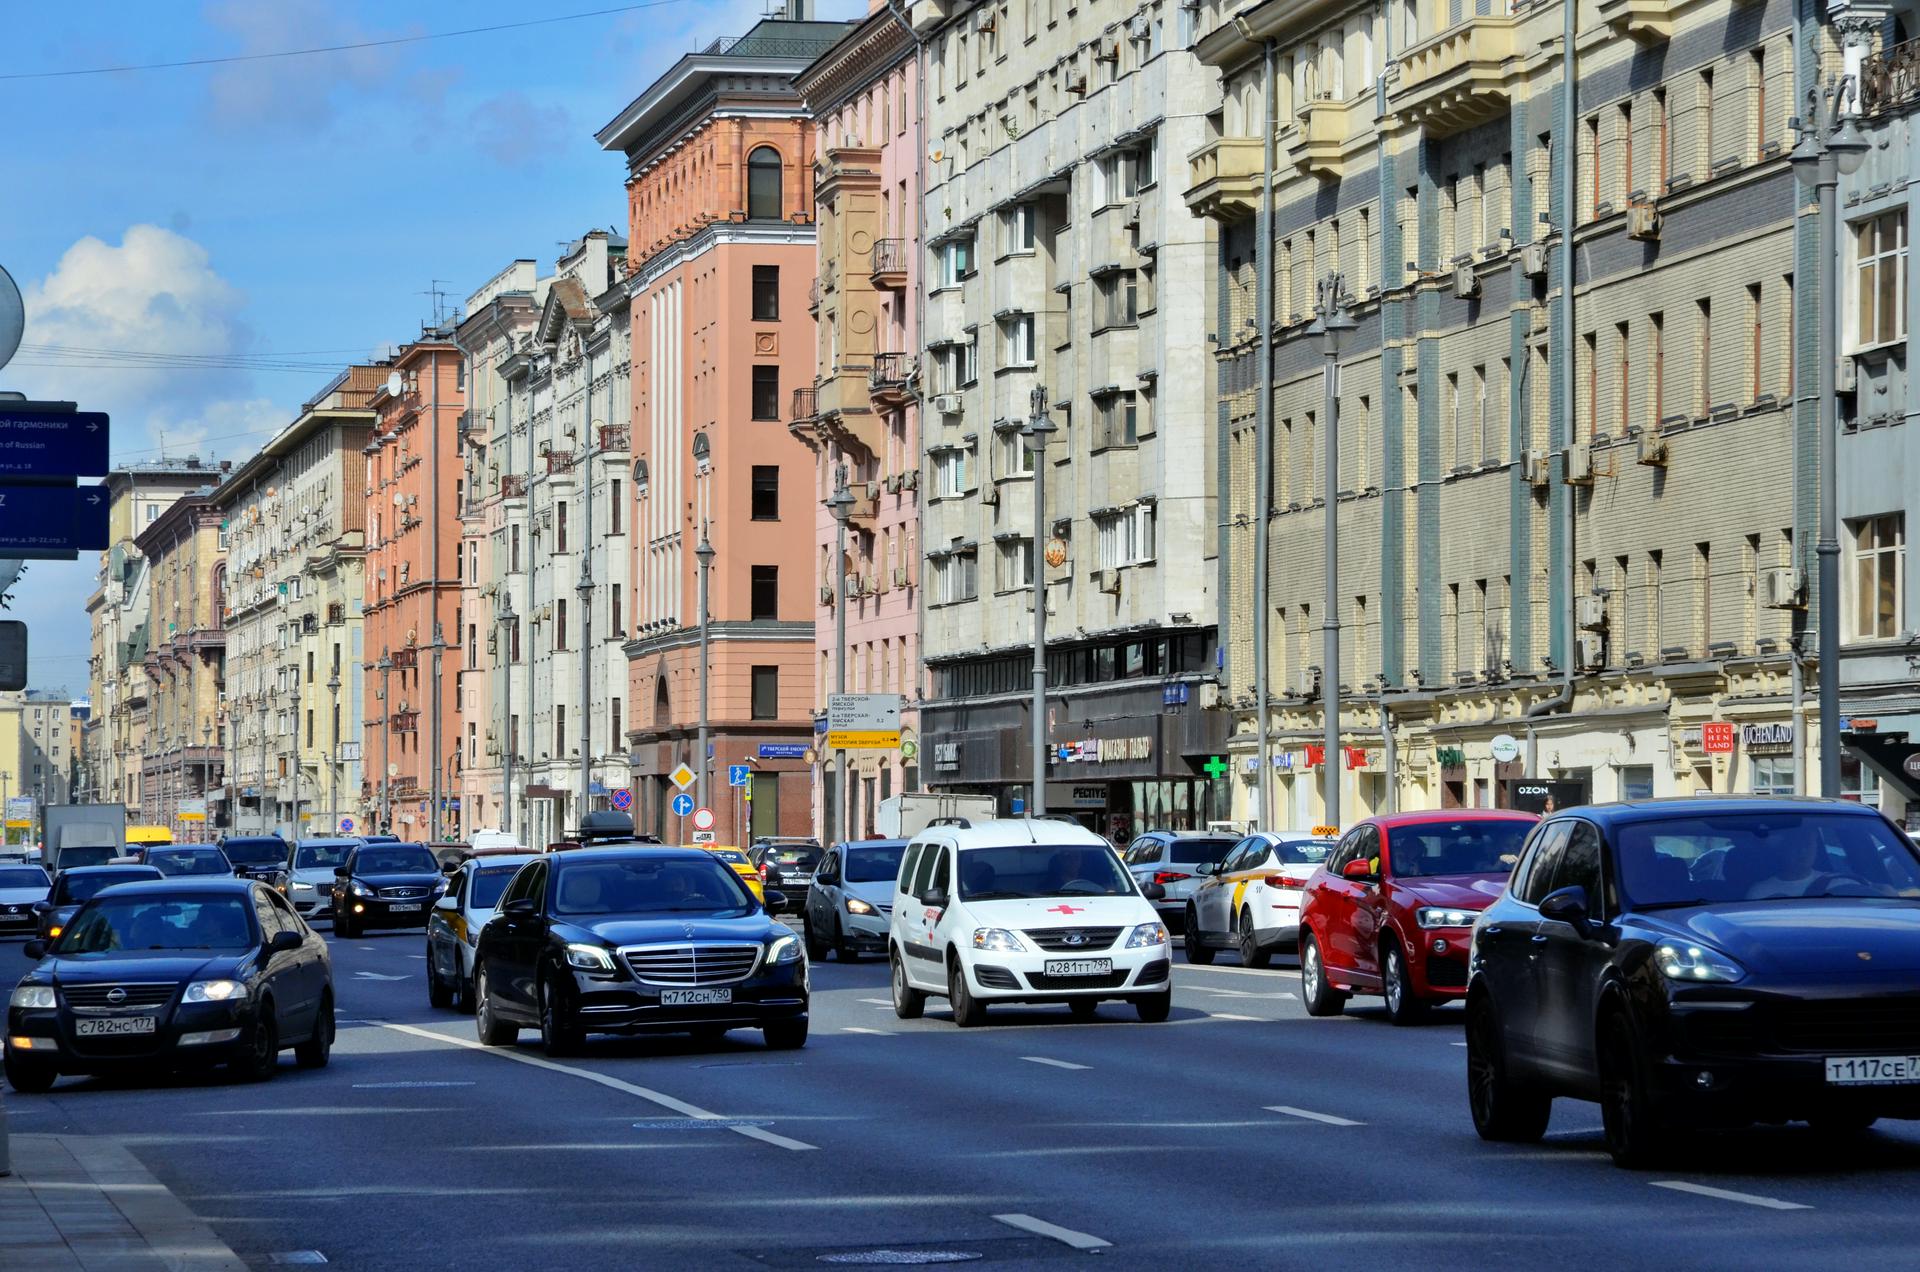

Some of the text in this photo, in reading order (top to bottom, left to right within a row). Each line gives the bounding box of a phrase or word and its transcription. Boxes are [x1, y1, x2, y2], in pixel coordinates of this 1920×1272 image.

[13, 420, 68, 431] гармоники
[15, 441, 46, 449] Russian
[1518, 786, 1549, 795] OZON
[1049, 960, 1109, 974] А281ТТ 799
[663, 989, 729, 1004] М712СН 750
[80, 1018, 151, 1034] С782НС 177
[1831, 1057, 1920, 1079] Т117СЕ 7
